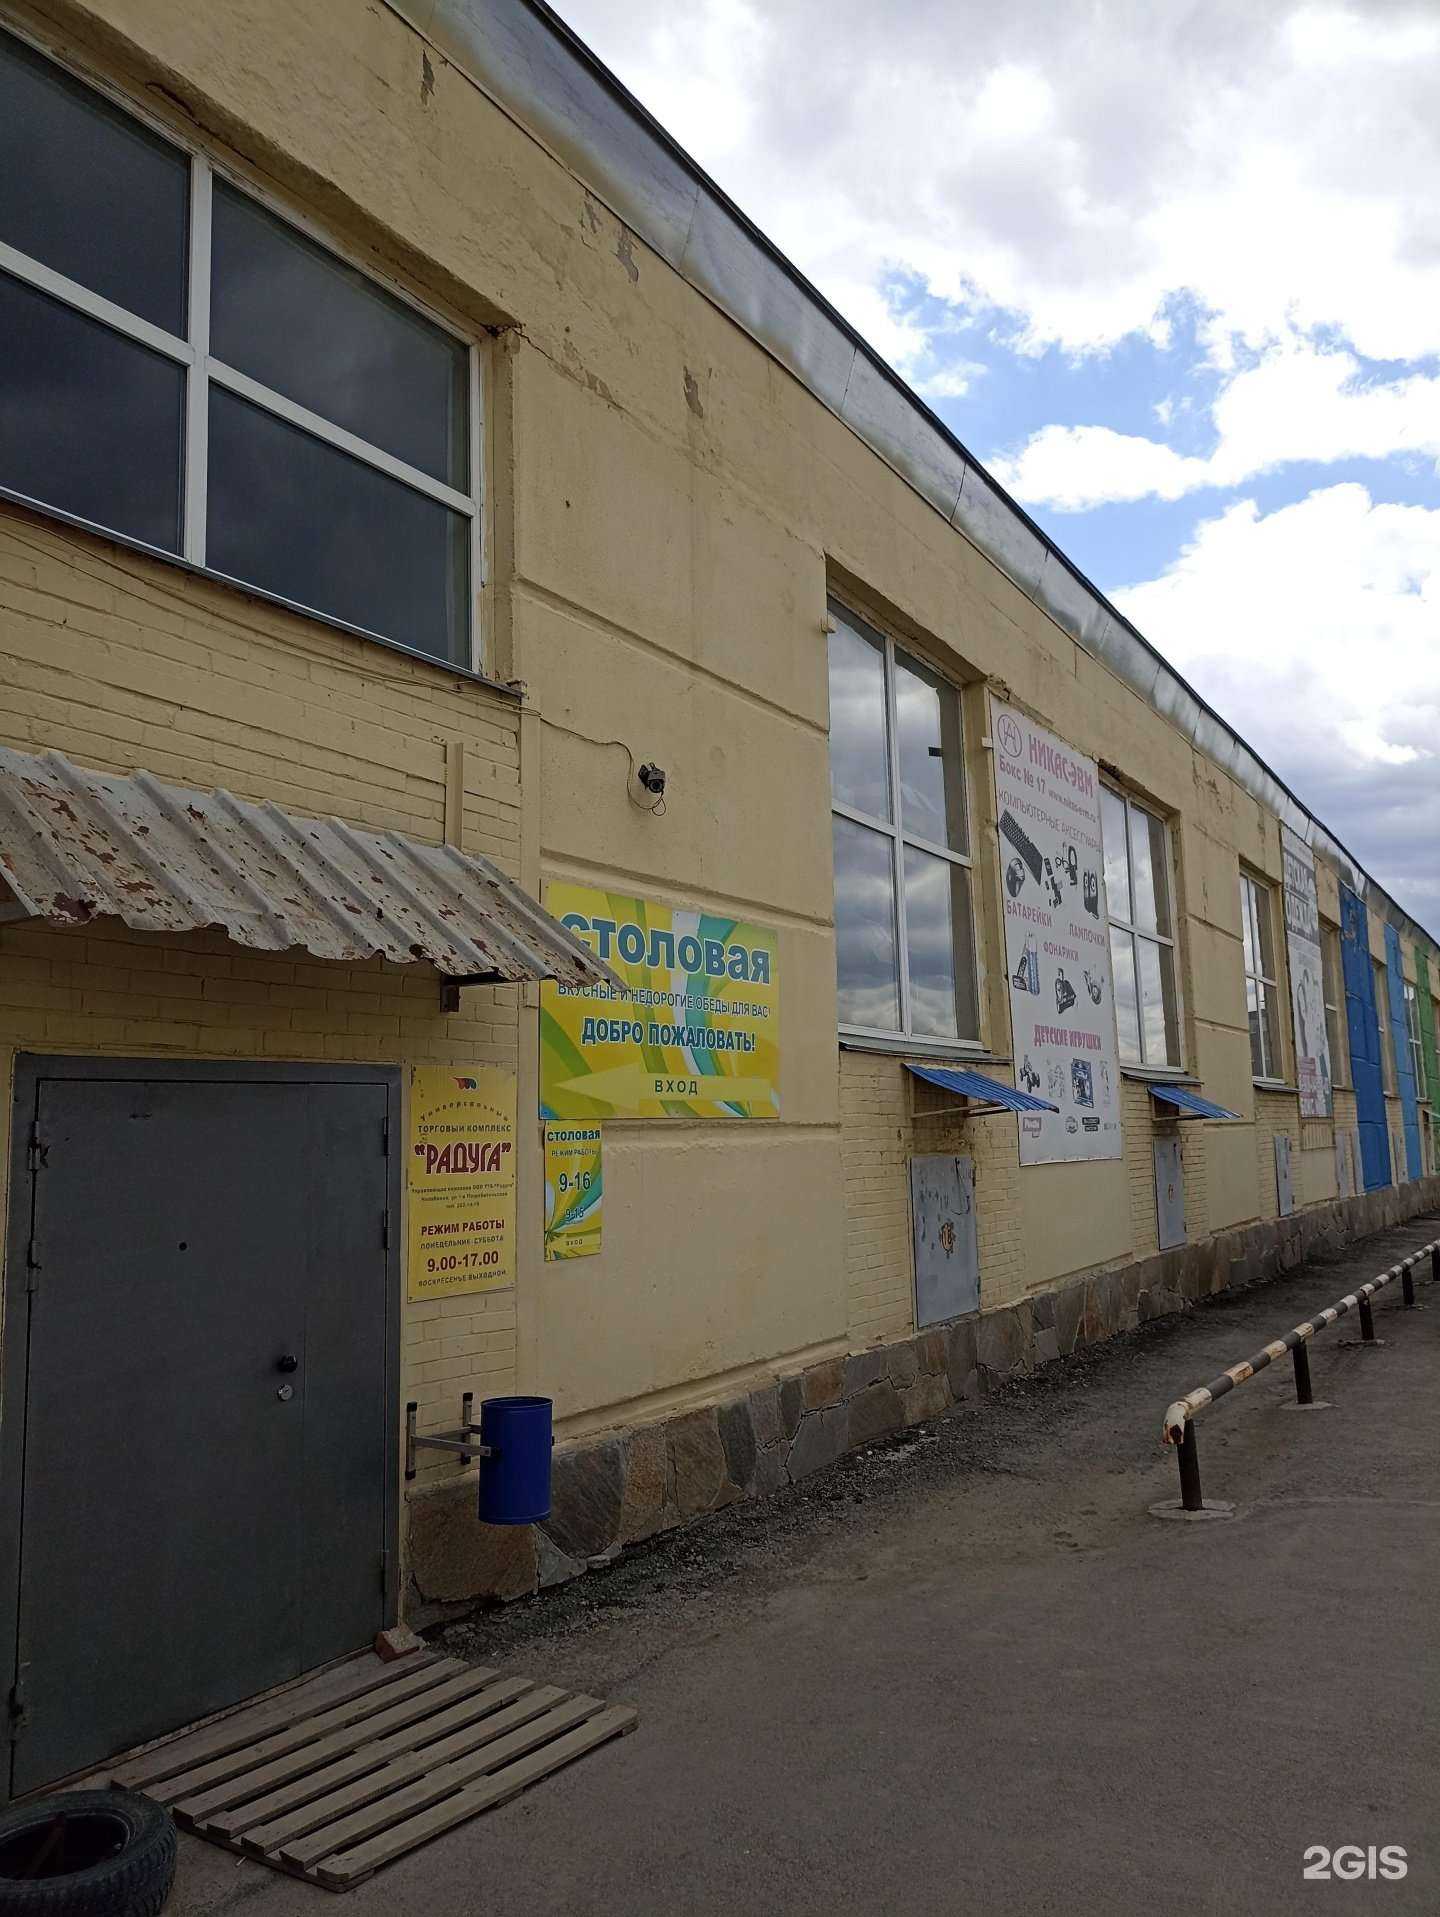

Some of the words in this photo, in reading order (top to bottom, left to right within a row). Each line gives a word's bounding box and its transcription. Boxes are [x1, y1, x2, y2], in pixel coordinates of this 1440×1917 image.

[1000, 754, 1021, 780] Бокс
[1024, 768, 1034, 787] №
[1037, 777, 1046, 794] 17
[1029, 734, 1093, 798] НИКАС-ЭВМ
[1006, 900, 1052, 927] БАТАРЕЙКИ
[1069, 924, 1105, 947] ЛАМПОЧКИ
[1043, 941, 1079, 961] ФОНАРИКИ
[631, 988, 694, 1009] НЕДОРОГИЕ
[696, 996, 730, 1015] ОБЕДЫ
[732, 1001, 750, 1017] ДЛЯ
[581, 1018, 643, 1045] ДОБРО
[648, 1023, 755, 1051] ПОЖАЛОВАТЬ!
[1034, 1025, 1068, 1047] ДЕТСКИЕ
[654, 1080, 698, 1095] ВХОД
[418, 1124, 464, 1133] ТОРГОВЫЙ
[467, 1124, 511, 1132] КОМПЛЕКС
[414, 1142, 512, 1175] "РАДУГА"
[559, 1171, 590, 1192] 9-16
[421, 1223, 459, 1236] РЕЖИМ
[462, 1219, 505, 1232] РАБОТЫ
[420, 1238, 470, 1250] ПОНЕДЕЛЬНИК
[474, 1235, 504, 1245] СУББОТА
[427, 1251, 499, 1273] 9.00-17.00
[418, 1276, 466, 1287] ВОСКРЕСЕНЬЕ
[468, 1269, 506, 1281] ВЫХОДНОЙ
